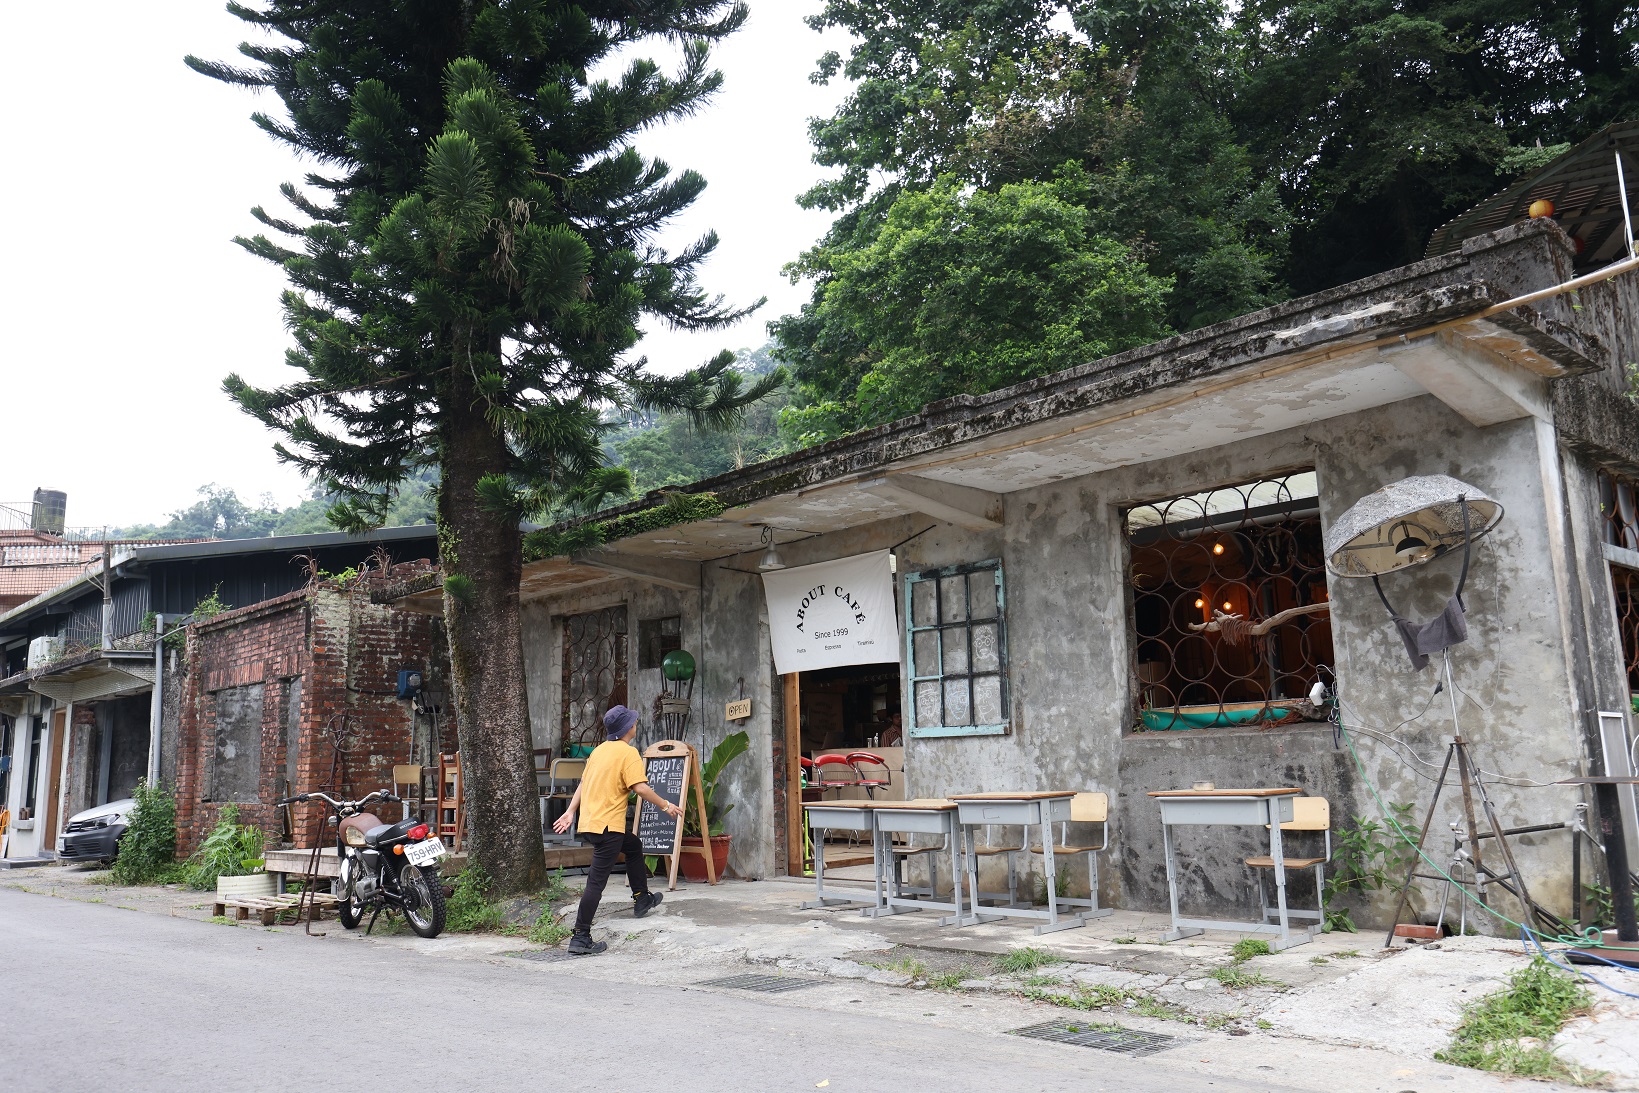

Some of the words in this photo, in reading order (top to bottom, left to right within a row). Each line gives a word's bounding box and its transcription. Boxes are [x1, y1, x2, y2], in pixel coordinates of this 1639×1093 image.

[796, 584, 826, 633] ABOUT
[834, 586, 866, 625] CAFE
[814, 631, 831, 639] Since
[833, 627, 849, 637] 1999
[728, 703, 748, 716] OPEN
[647, 758, 677, 773] ABOUT
